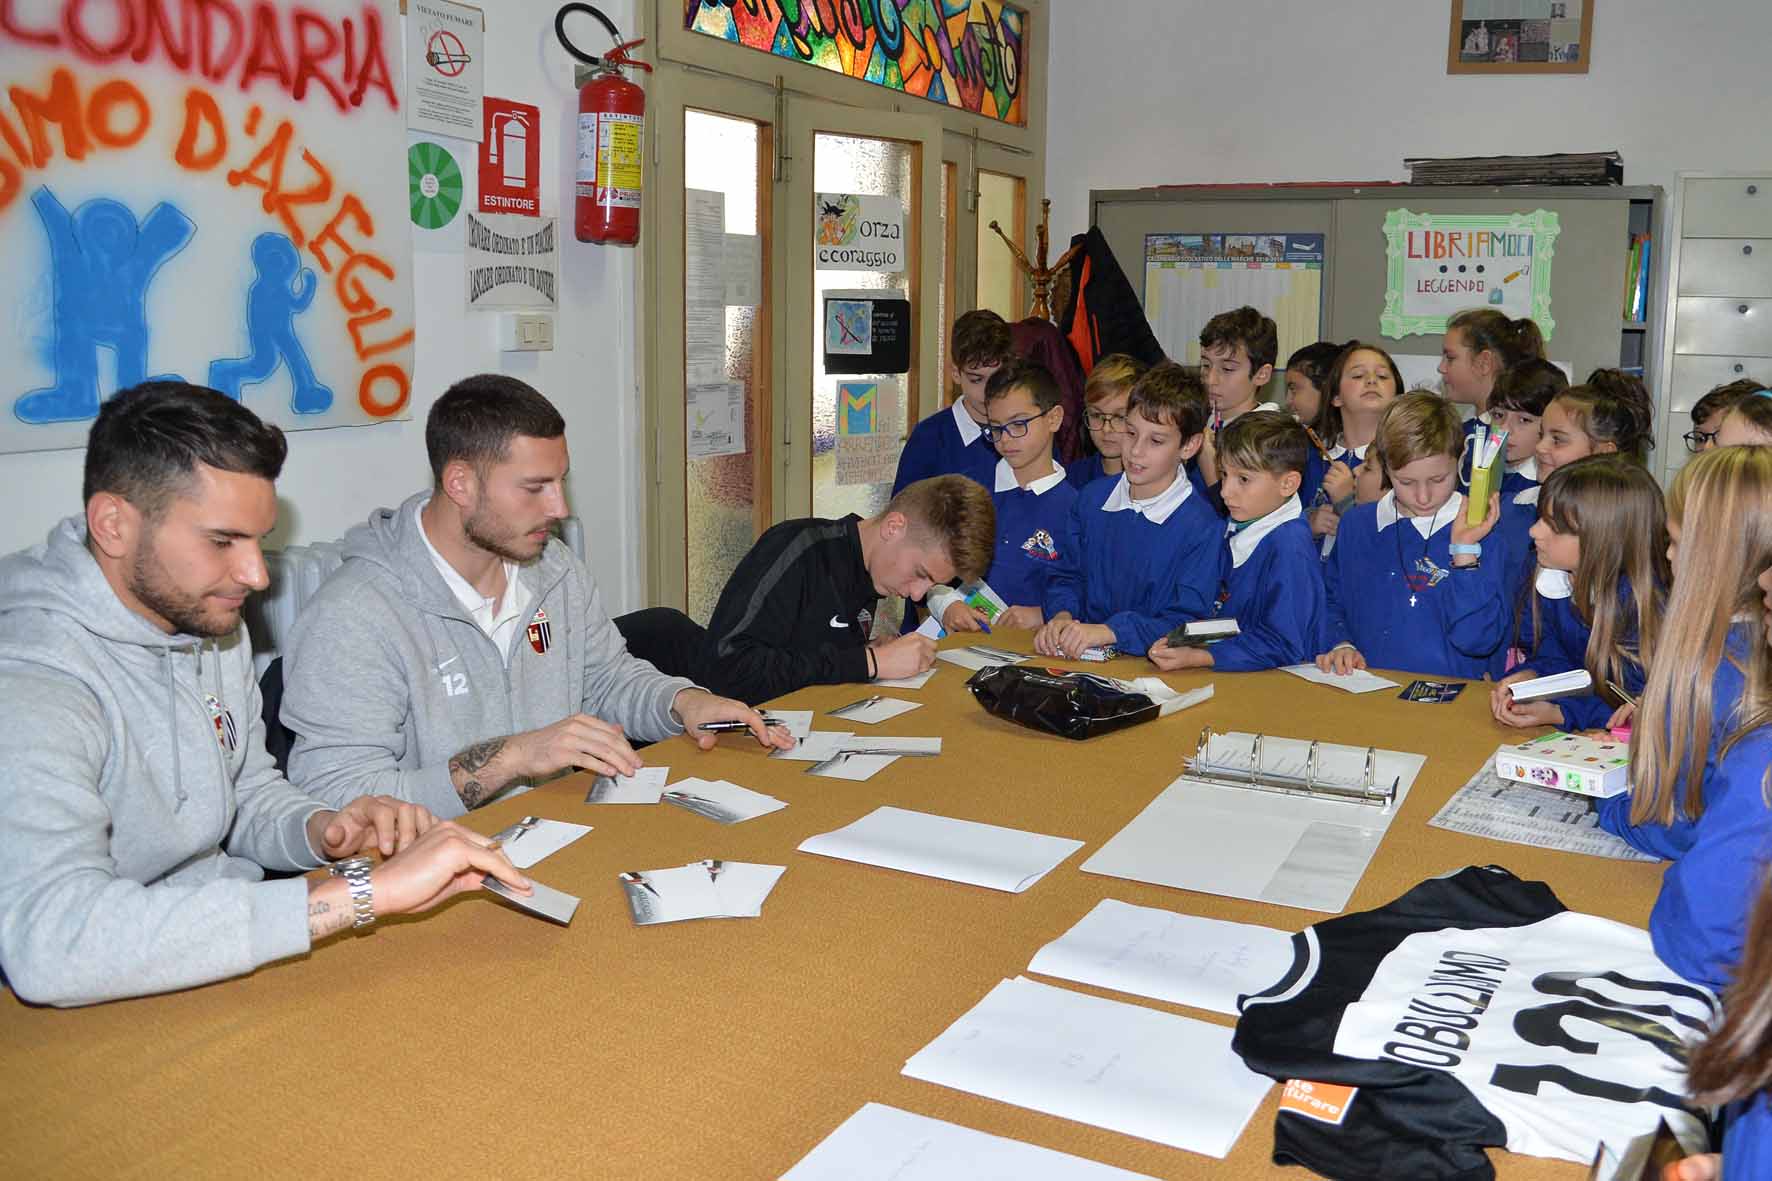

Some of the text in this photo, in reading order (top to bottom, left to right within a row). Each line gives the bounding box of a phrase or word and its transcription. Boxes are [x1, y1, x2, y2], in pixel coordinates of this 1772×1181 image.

[416, 4, 473, 27] VIETATO FUMARE
[0, 67, 152, 214] IMO
[484, 195, 535, 210] ESTINTORE
[1407, 230, 1534, 259] LIBRIAMOCI
[1416, 279, 1485, 293] LEGGENDO
[442, 672, 469, 697] 12
